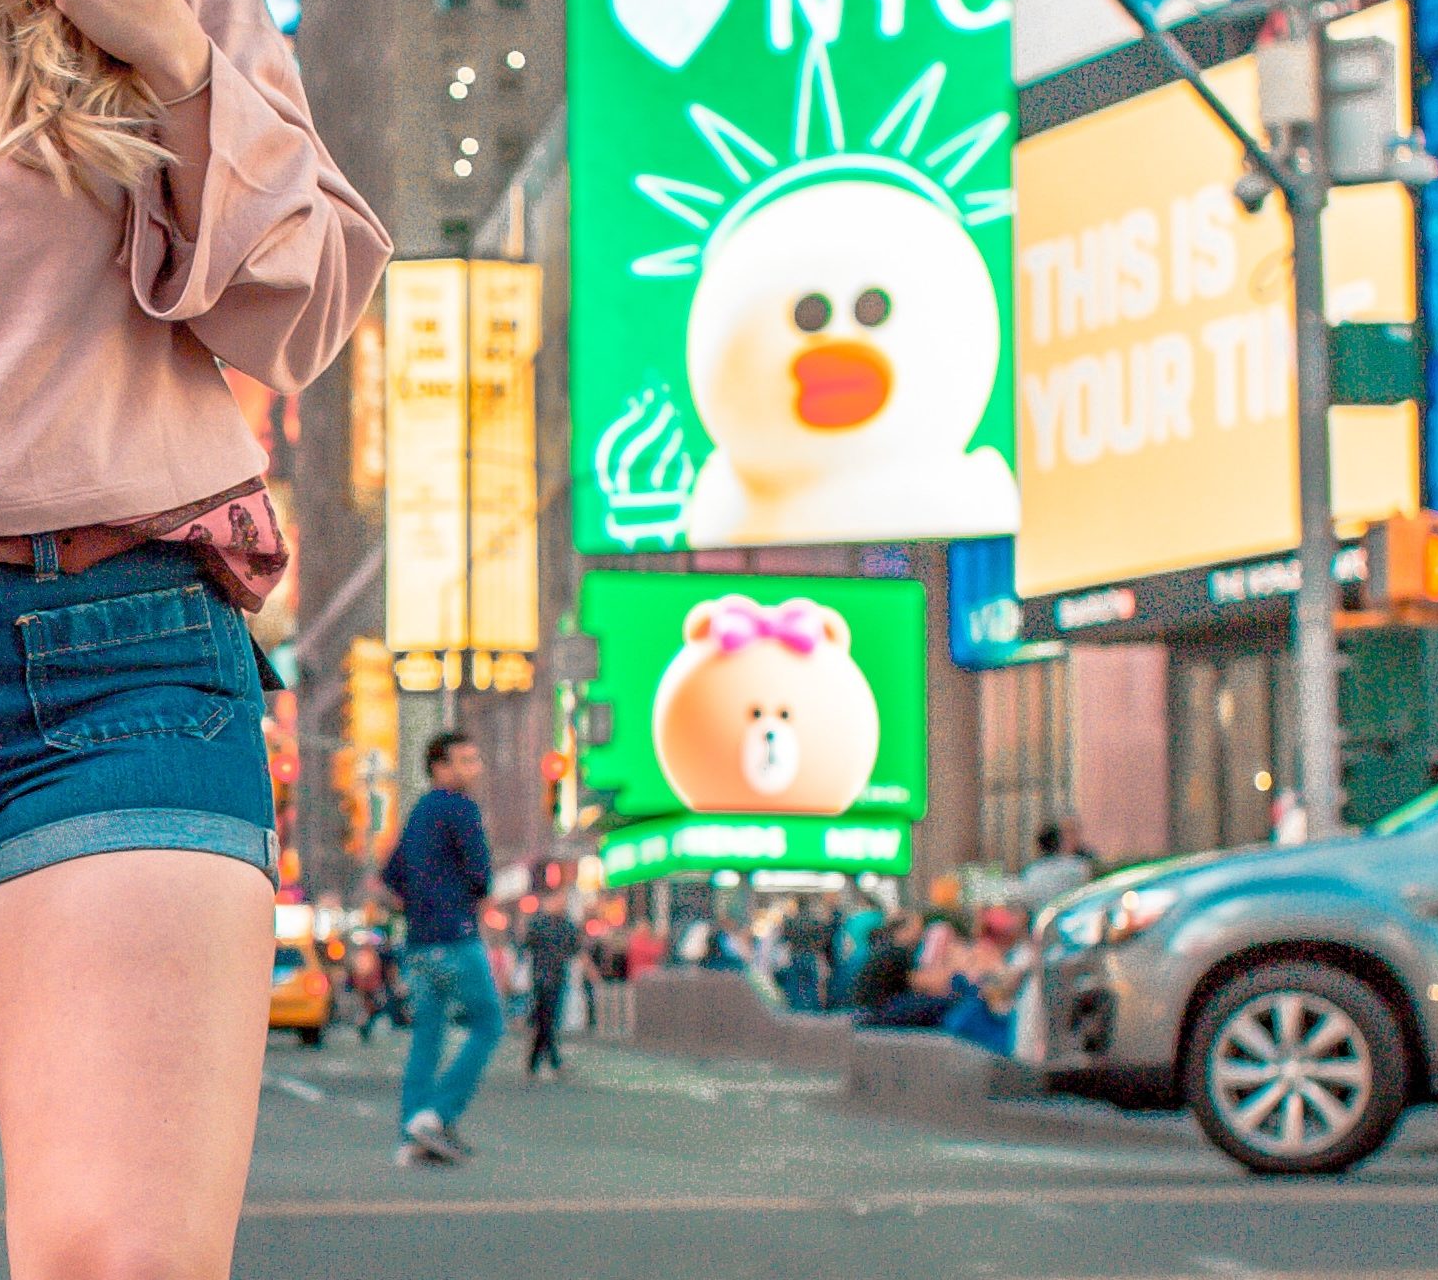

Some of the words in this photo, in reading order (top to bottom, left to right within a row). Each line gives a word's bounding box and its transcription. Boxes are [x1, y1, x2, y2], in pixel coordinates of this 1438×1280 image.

[1022, 210, 1163, 347] THIS
[1172, 186, 1239, 305] IS
[1022, 335, 1191, 474] YOUR
